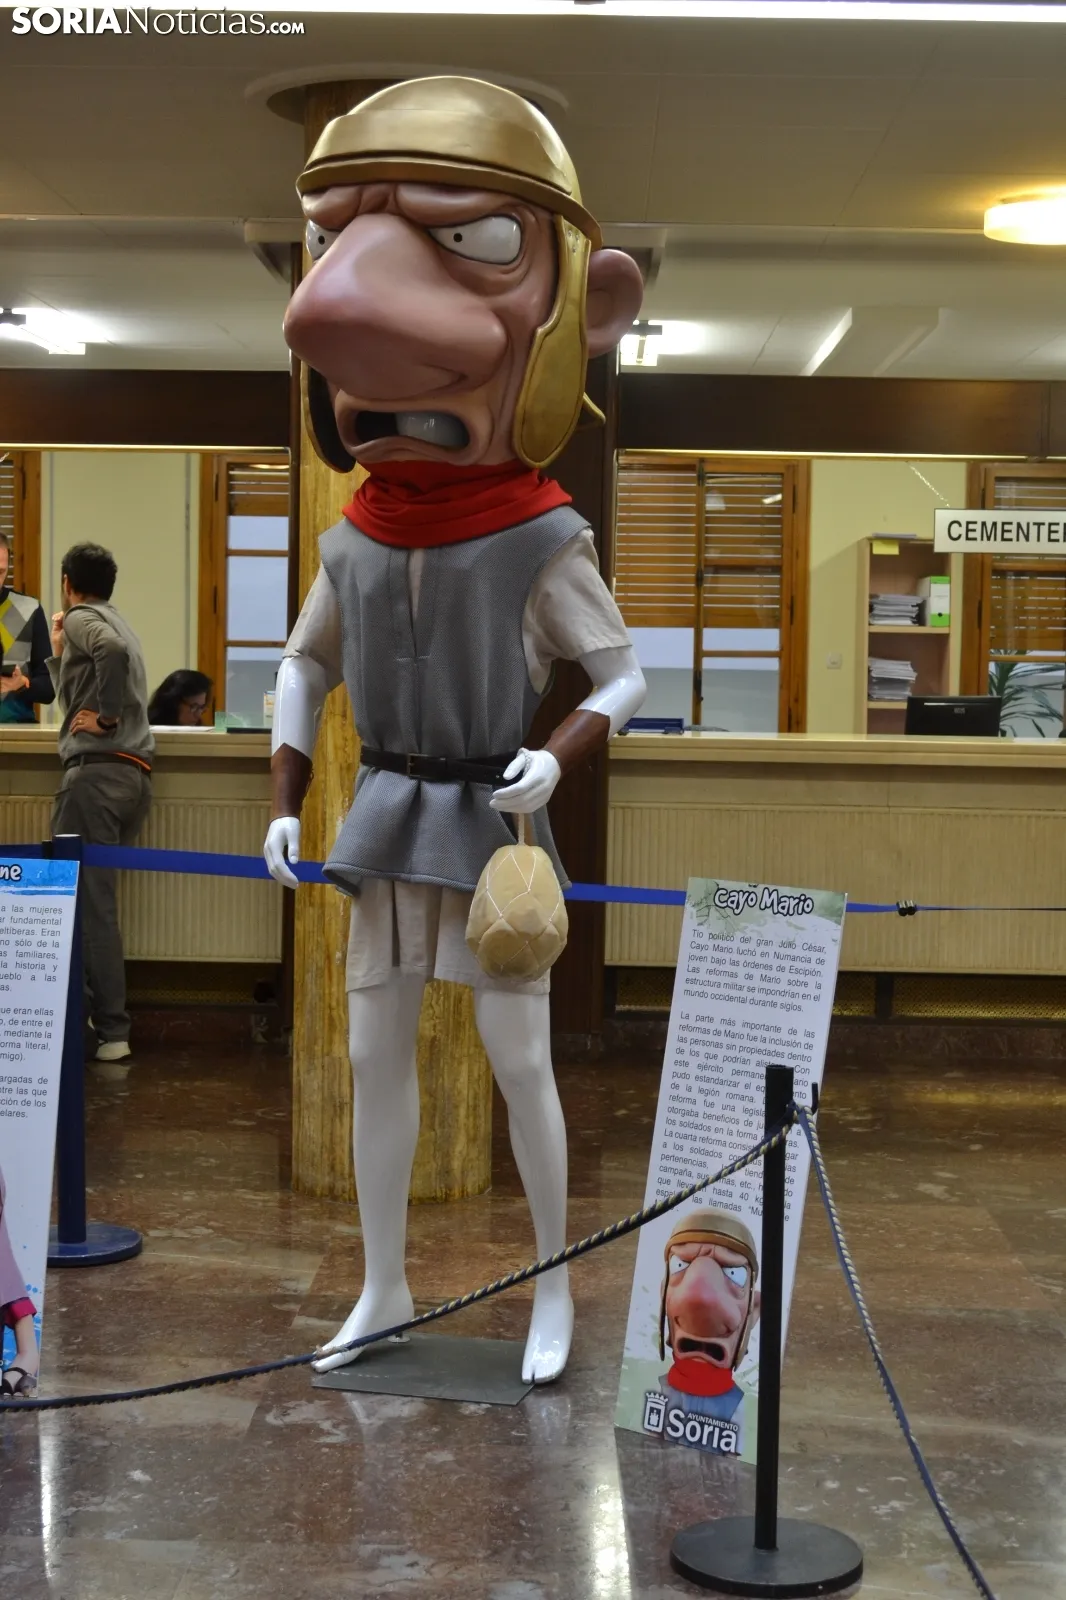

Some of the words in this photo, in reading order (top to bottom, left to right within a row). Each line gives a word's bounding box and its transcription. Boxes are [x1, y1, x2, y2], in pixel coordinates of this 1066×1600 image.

[947, 520, 1066, 543] CEMENTE
[29, 906, 62, 915] mujeres
[714, 887, 758, 915] Cayo
[760, 887, 814, 916] Mario
[11, 916, 61, 925] fundamental
[15, 939, 32, 948] sólo
[37, 940, 47, 948] de
[52, 940, 59, 948] la
[690, 940, 709, 952] Cayo
[712, 943, 733, 953] Mario
[736, 947, 756, 956] luchó
[773, 951, 811, 963] Numancia
[815, 957, 825, 965] de
[708, 932, 734, 942] político
[756, 938, 773, 947] gran
[778, 940, 796, 949] Julio
[801, 942, 826, 954] César,
[15, 962, 45, 971] historia
[687, 953, 707, 962] joven
[710, 956, 726, 966] bajo
[729, 957, 740, 966] las
[742, 960, 773, 971] órdenes
[775, 964, 785, 972] de
[788, 965, 823, 977] Escipión.
[686, 964, 700, 973] Las
[705, 967, 738, 978] reformas
[743, 972, 753, 980] de
[759, 973, 781, 984] Mario
[787, 978, 808, 988] sobre
[814, 981, 821, 989] la
[685, 977, 721, 988] estructura
[722, 982, 745, 991] militar
[746, 985, 756, 993] se
[757, 987, 799, 998] impondrían
[683, 989, 708, 998] mundo
[710, 992, 747, 1003] occidental
[748, 997, 777, 1008] durante
[779, 1002, 803, 1012] siglos.
[34, 1008, 53, 1016] ellas
[680, 1011, 689, 1020] La
[695, 1014, 714, 1023] parte
[720, 1018, 735, 1026] más
[741, 1021, 781, 1033] importante
[787, 1027, 797, 1035] de
[803, 1029, 815, 1038] las
[4, 1030, 42, 1039] mediante
[45, 1030, 52, 1039] la
[678, 1023, 710, 1035] reformas
[712, 1028, 722, 1036] de
[723, 1029, 744, 1040] Mario
[746, 1032, 758, 1042] fue
[759, 1034, 766, 1043] la
[768, 1036, 801, 1048] inclusión
[803, 1042, 813, 1050] de
[675, 1046, 685, 1055] de
[689, 1048, 699, 1057] los
[704, 1052, 718, 1060] que
[722, 1055, 750, 1065] podrían
[677, 1034, 687, 1043] las
[689, 1038, 723, 1049] personas
[738, 1045, 785, 1058] propiedades
[787, 1052, 812, 1062] dentro
[673, 1059, 689, 1067] este
[697, 1062, 723, 1073] ejército
[671, 1071, 690, 1080] pudo
[694, 1074, 740, 1087] estandarizar
[16, 1087, 28, 1095] las
[32, 1089, 47, 1098] que
[670, 1082, 680, 1090] de
[685, 1084, 692, 1092] la
[698, 1086, 719, 1097] legión
[21, 1098, 31, 1106] de
[35, 1099, 46, 1107] los
[668, 1094, 696, 1105] reforma
[703, 1098, 715, 1108] fue
[721, 1104, 735, 1112] una
[667, 1106, 699, 1117] otorgaba
[702, 1110, 739, 1125] beneficios
[743, 1118, 753, 1127] de
[664, 1128, 673, 1137] La
[674, 1131, 697, 1141] cuarta
[698, 1136, 726, 1147] reforma
[665, 1116, 676, 1125] los
[678, 1120, 711, 1132] soldados
[714, 1126, 723, 1134] en
[726, 1127, 733, 1136] la
[736, 1129, 757, 1140] forma
[673, 1142, 683, 1151] los
[689, 1146, 722, 1158] soldados
[660, 1153, 708, 1168] pertenencias,
[659, 1165, 693, 1178] campaña,
[657, 1177, 671, 1185] que
[712, 1187, 732, 1198] hasta
[739, 1192, 749, 1201] 40
[692, 1194, 702, 1204] las
[708, 1198, 741, 1212] llamadas
[666, 1408, 737, 1453] Soria
[687, 1412, 738, 1431] AYUNTAMIENTO
